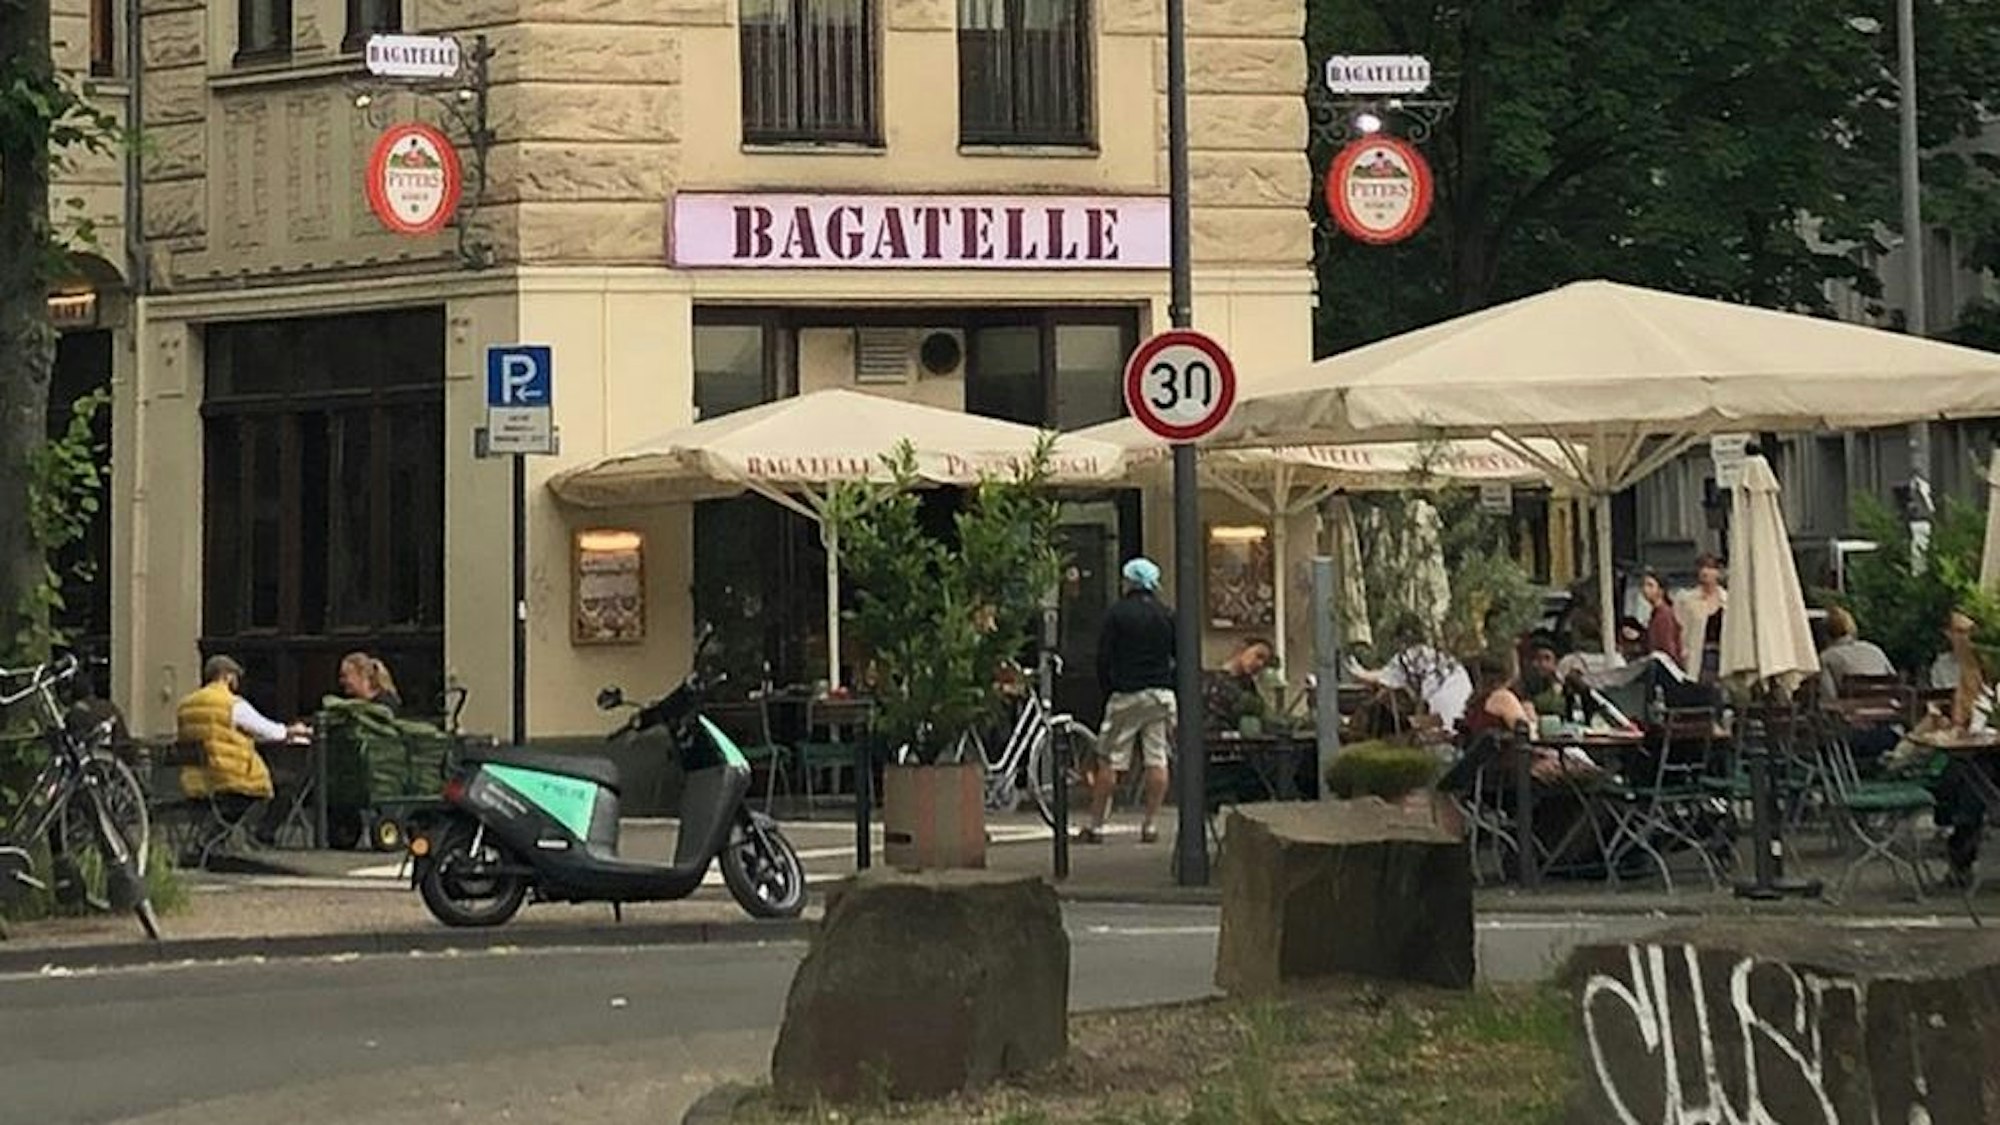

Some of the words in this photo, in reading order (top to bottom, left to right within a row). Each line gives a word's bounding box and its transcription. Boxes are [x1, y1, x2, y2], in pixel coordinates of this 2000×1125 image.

[371, 46, 456, 66] BAGATELLE
[1331, 65, 1428, 82] BAGATELLE
[733, 206, 1119, 260] BAGATELLE
[503, 353, 537, 403] P
[1151, 361, 1212, 409] 30
